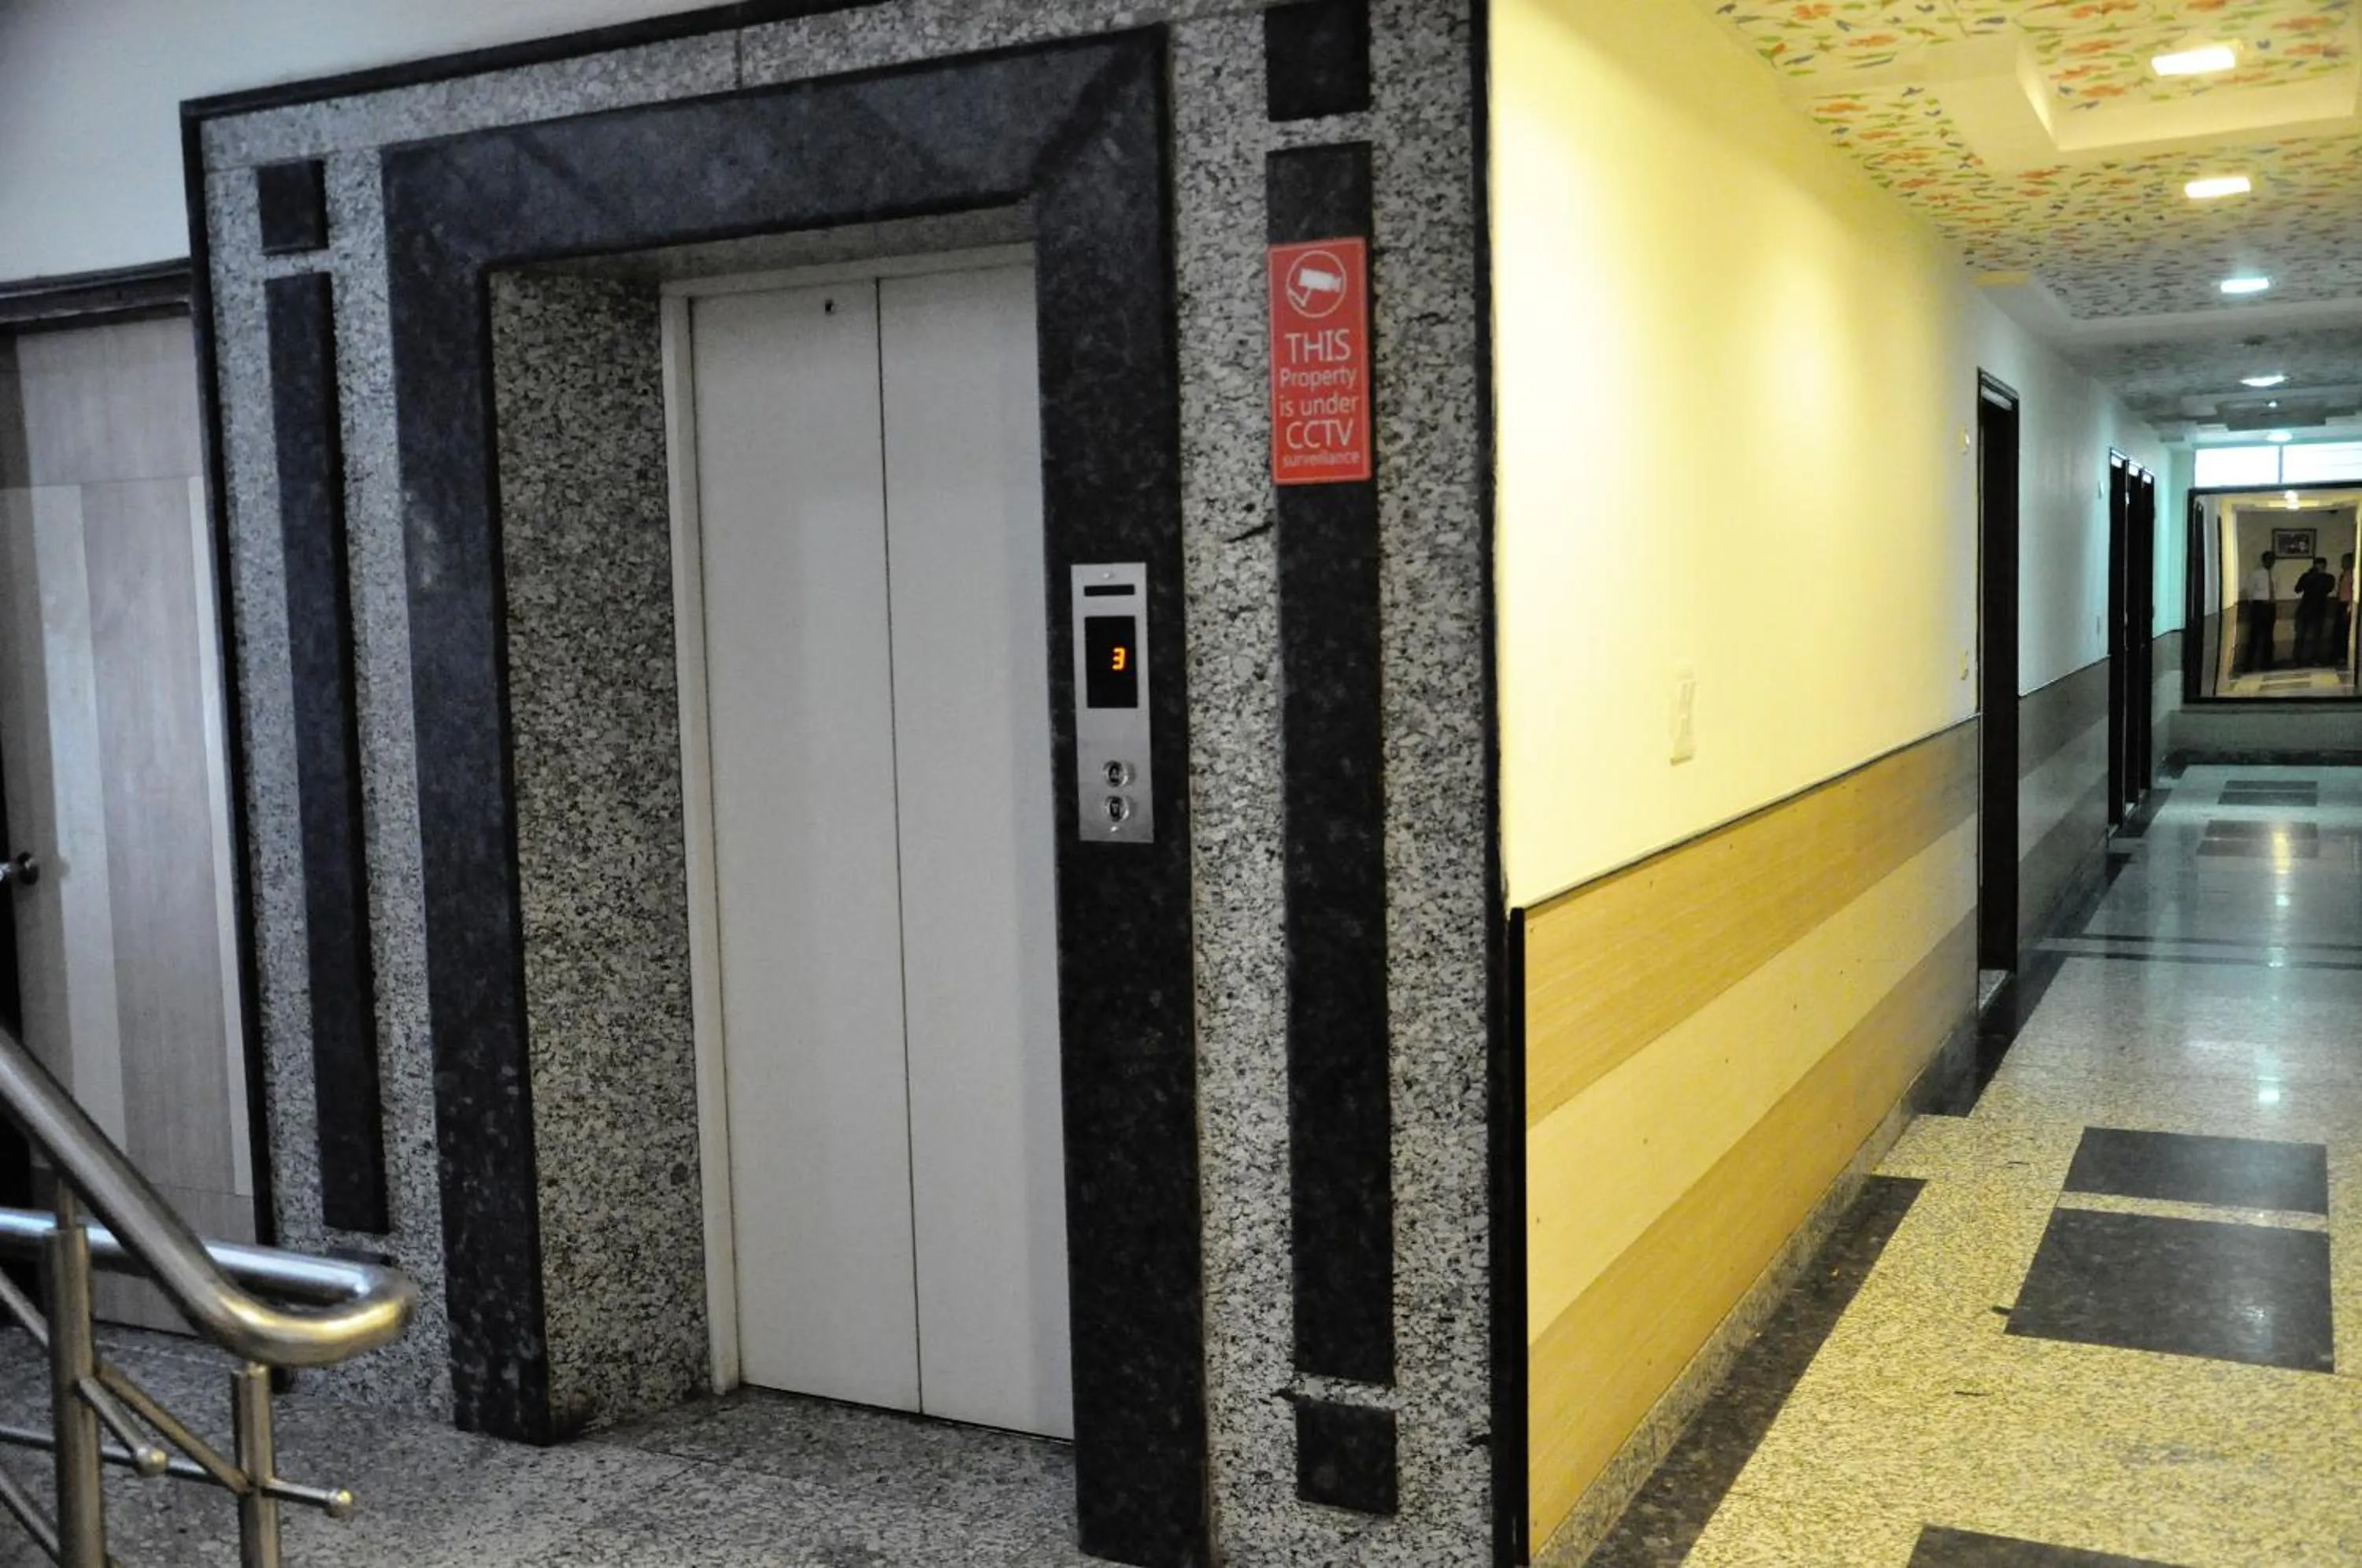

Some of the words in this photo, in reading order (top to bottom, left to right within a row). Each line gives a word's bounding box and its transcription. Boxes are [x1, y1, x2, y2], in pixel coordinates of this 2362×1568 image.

[1284, 328, 1351, 363] THIS
[1280, 367, 1357, 392] Property
[1279, 396, 1294, 416] is
[1301, 392, 1359, 416] under
[1286, 419, 1354, 449] CCTV
[1112, 647, 1126, 670] 3
